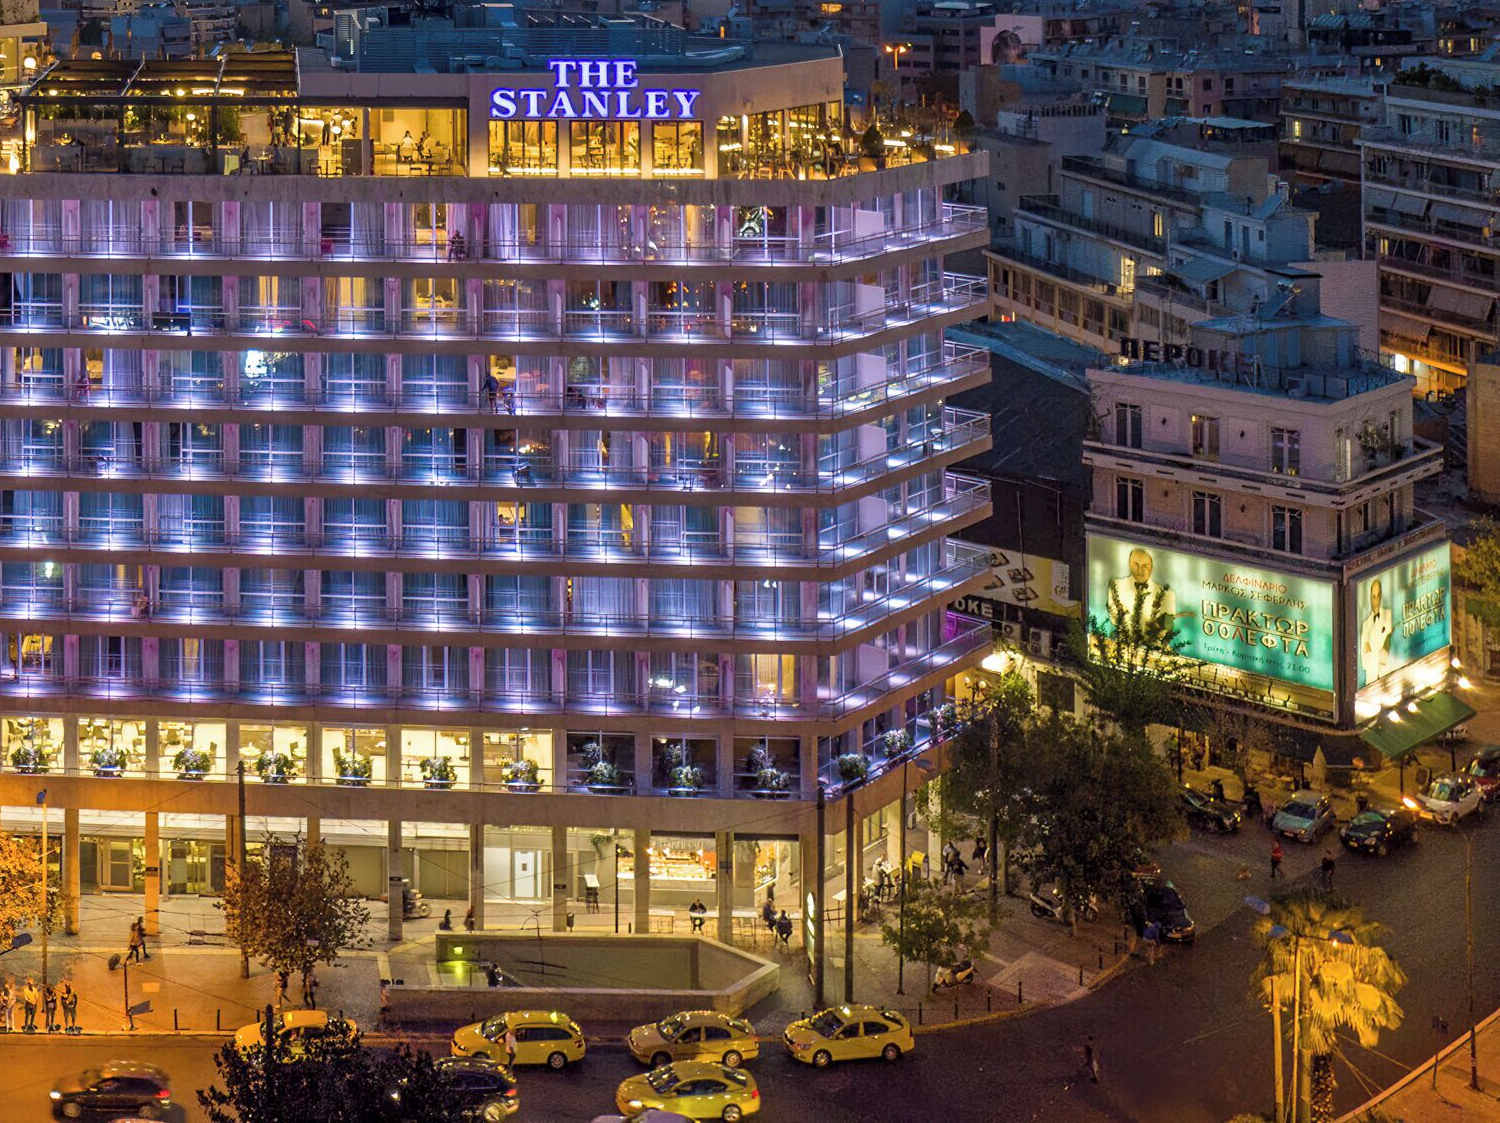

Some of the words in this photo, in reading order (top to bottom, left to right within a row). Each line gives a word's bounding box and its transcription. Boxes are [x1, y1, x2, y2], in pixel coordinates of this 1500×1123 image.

[549, 59, 638, 88] THE
[491, 88, 700, 118] STANLEY
[1202, 580, 1246, 598] ΜΑΡΚΟΣ
[1202, 599, 1309, 636] ΠΡΑΚΤΩΡ
